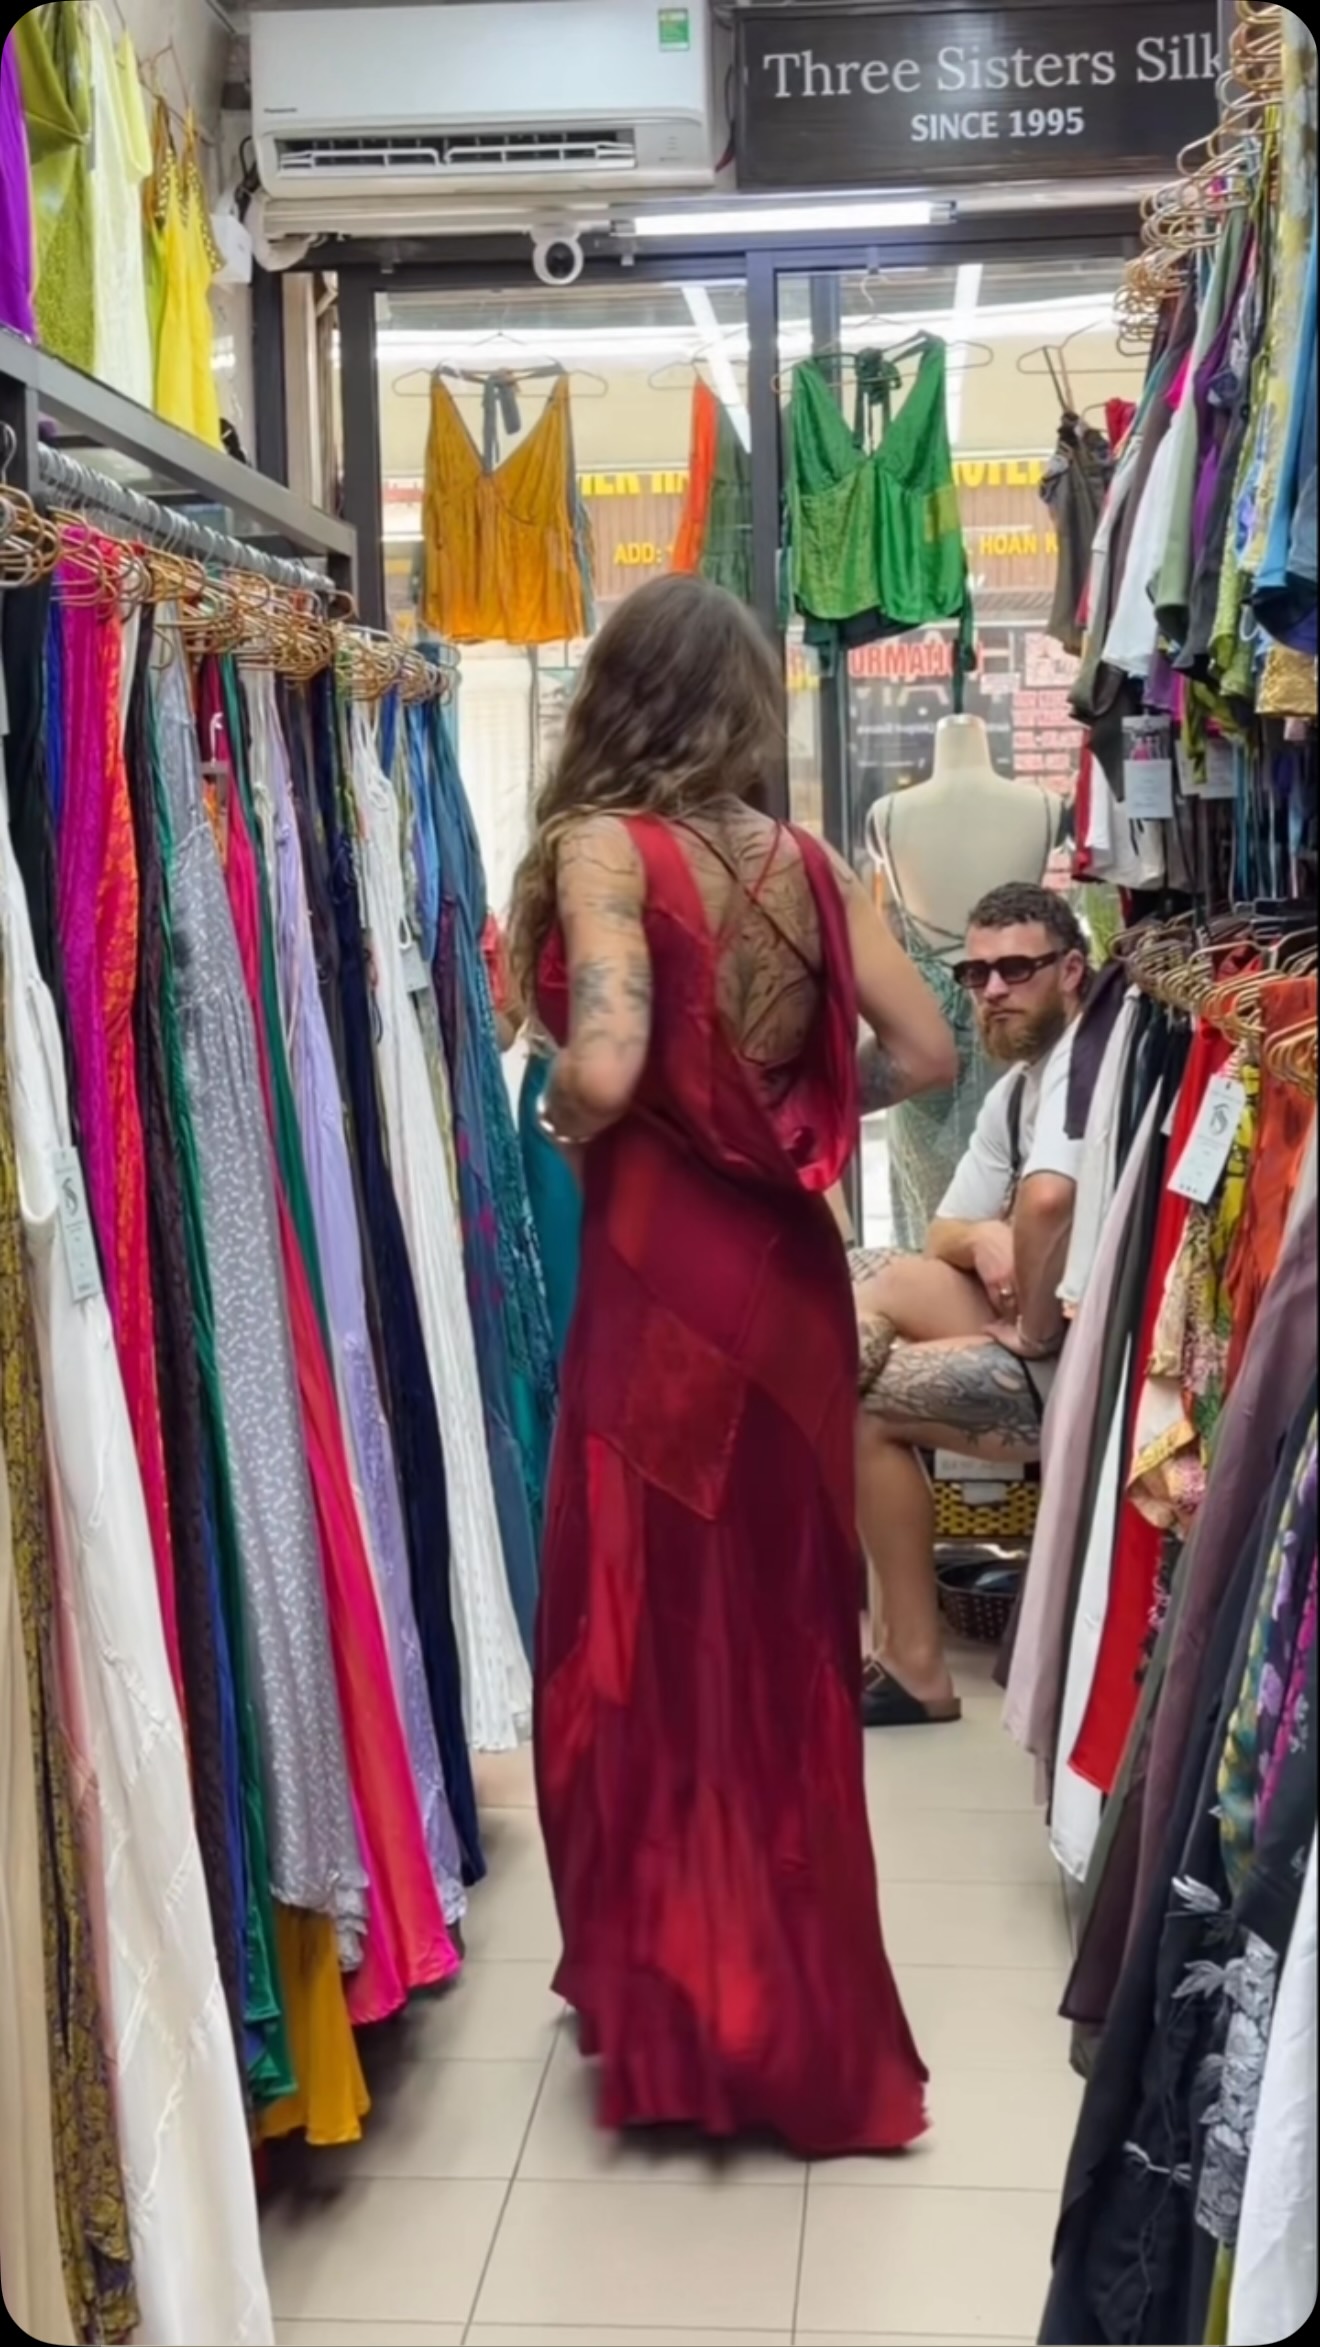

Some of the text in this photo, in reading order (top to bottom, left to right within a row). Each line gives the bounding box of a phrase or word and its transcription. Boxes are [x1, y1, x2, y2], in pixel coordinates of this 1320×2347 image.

[763, 50, 921, 99] Three
[936, 46, 1117, 92] Sisters
[910, 106, 1085, 143] SINCE 1995
[613, 543, 662, 566] ADD:
